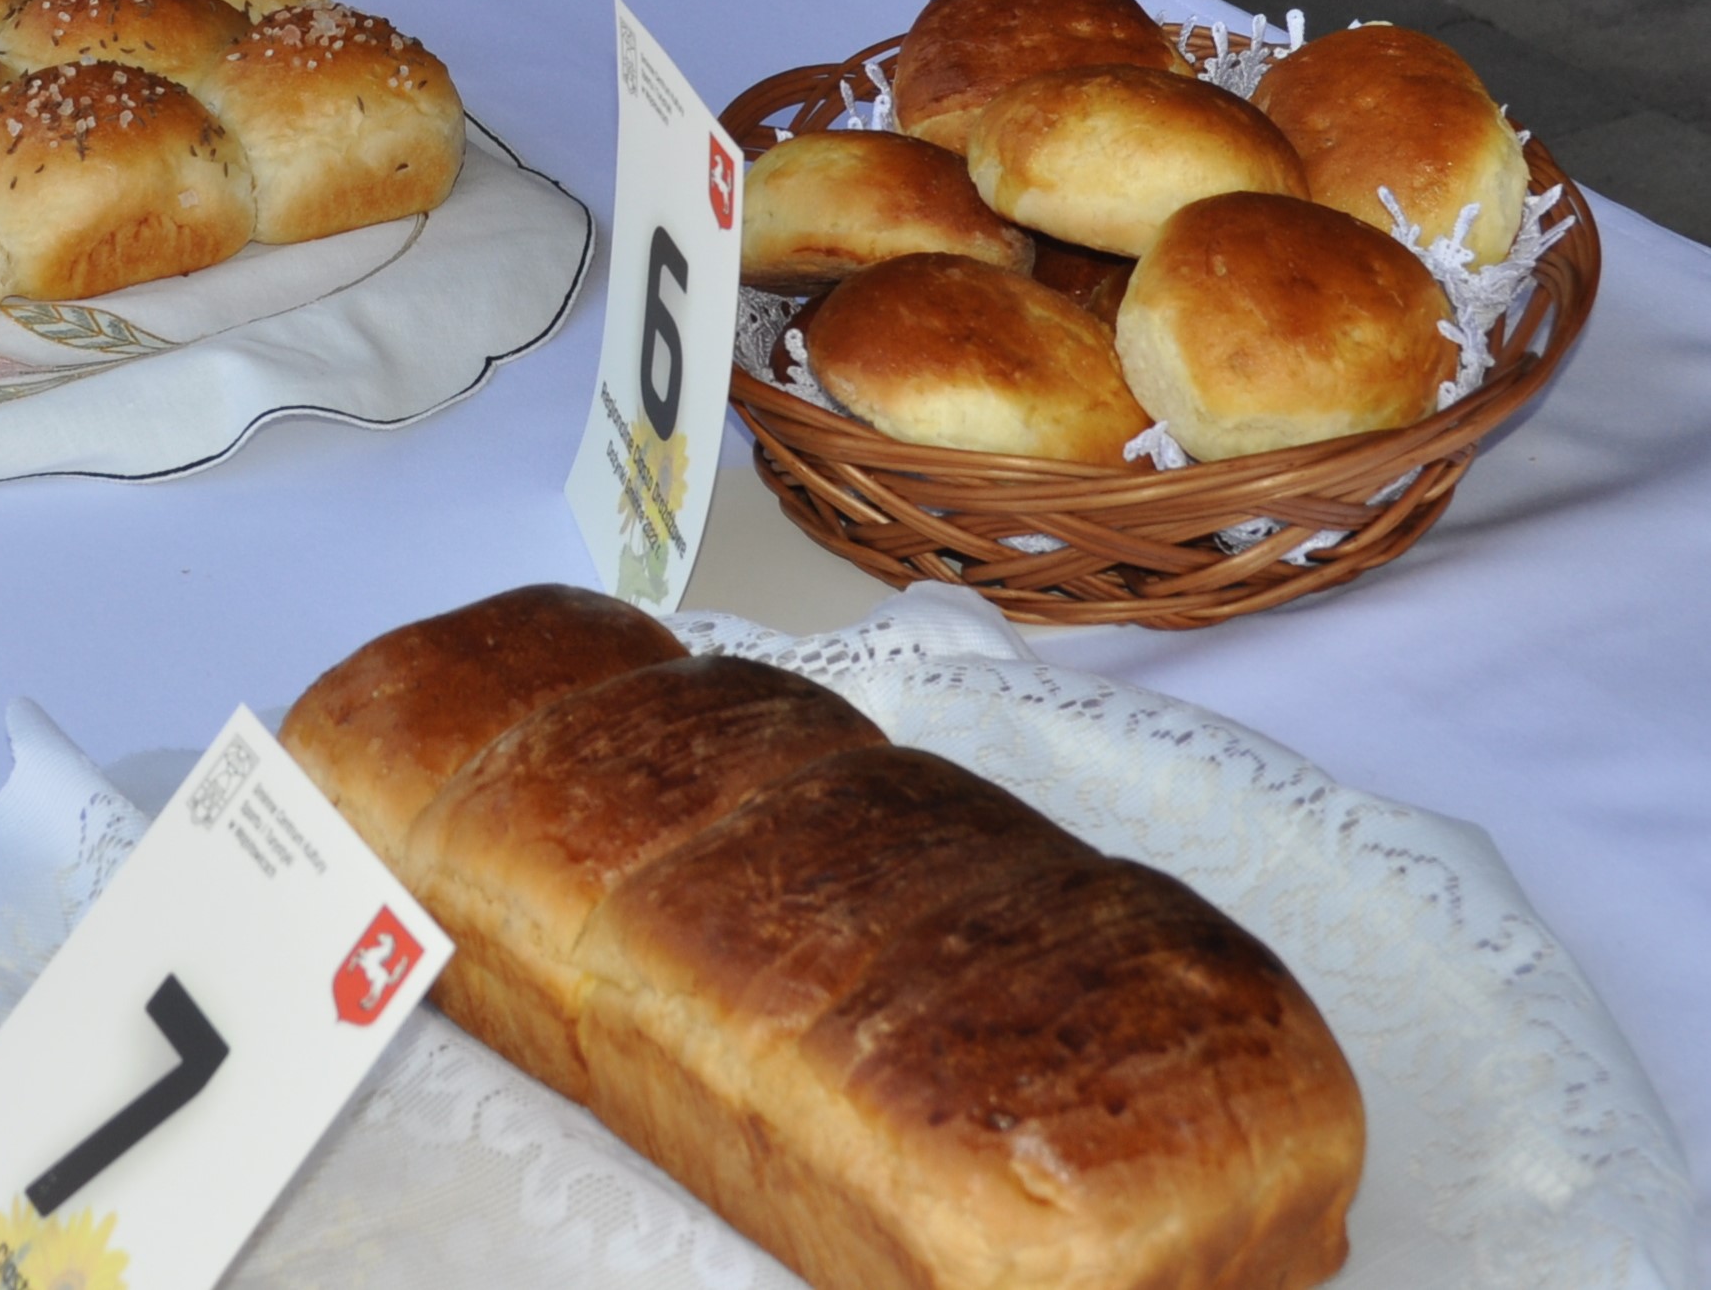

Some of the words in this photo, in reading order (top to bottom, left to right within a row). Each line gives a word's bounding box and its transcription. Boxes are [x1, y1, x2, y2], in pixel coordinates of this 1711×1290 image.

[601, 380, 634, 455] Regionalne
[633, 444, 654, 492] Ciasto
[640, 225, 689, 442] 6
[24, 972, 230, 1219] 7
